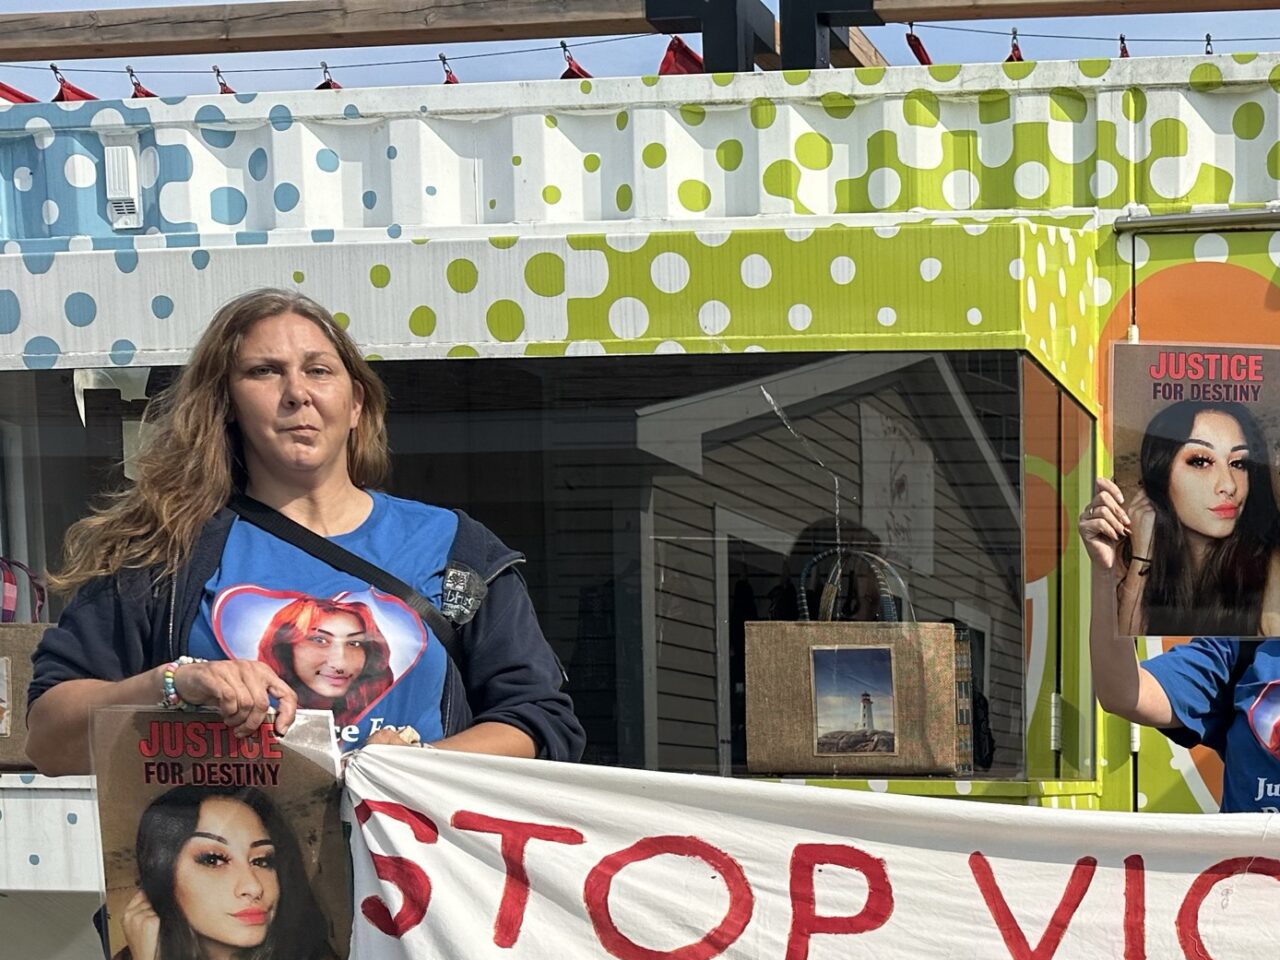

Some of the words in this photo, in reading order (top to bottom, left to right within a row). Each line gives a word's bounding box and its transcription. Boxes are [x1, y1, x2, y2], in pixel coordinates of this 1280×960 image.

[1149, 352, 1264, 381] JUSTICE
[1152, 383, 1184, 400] FOR
[1191, 384, 1261, 402] DESTINY
[139, 720, 283, 759] JUSTICE
[144, 761, 184, 785] FOR
[192, 762, 281, 786] DESTINY
